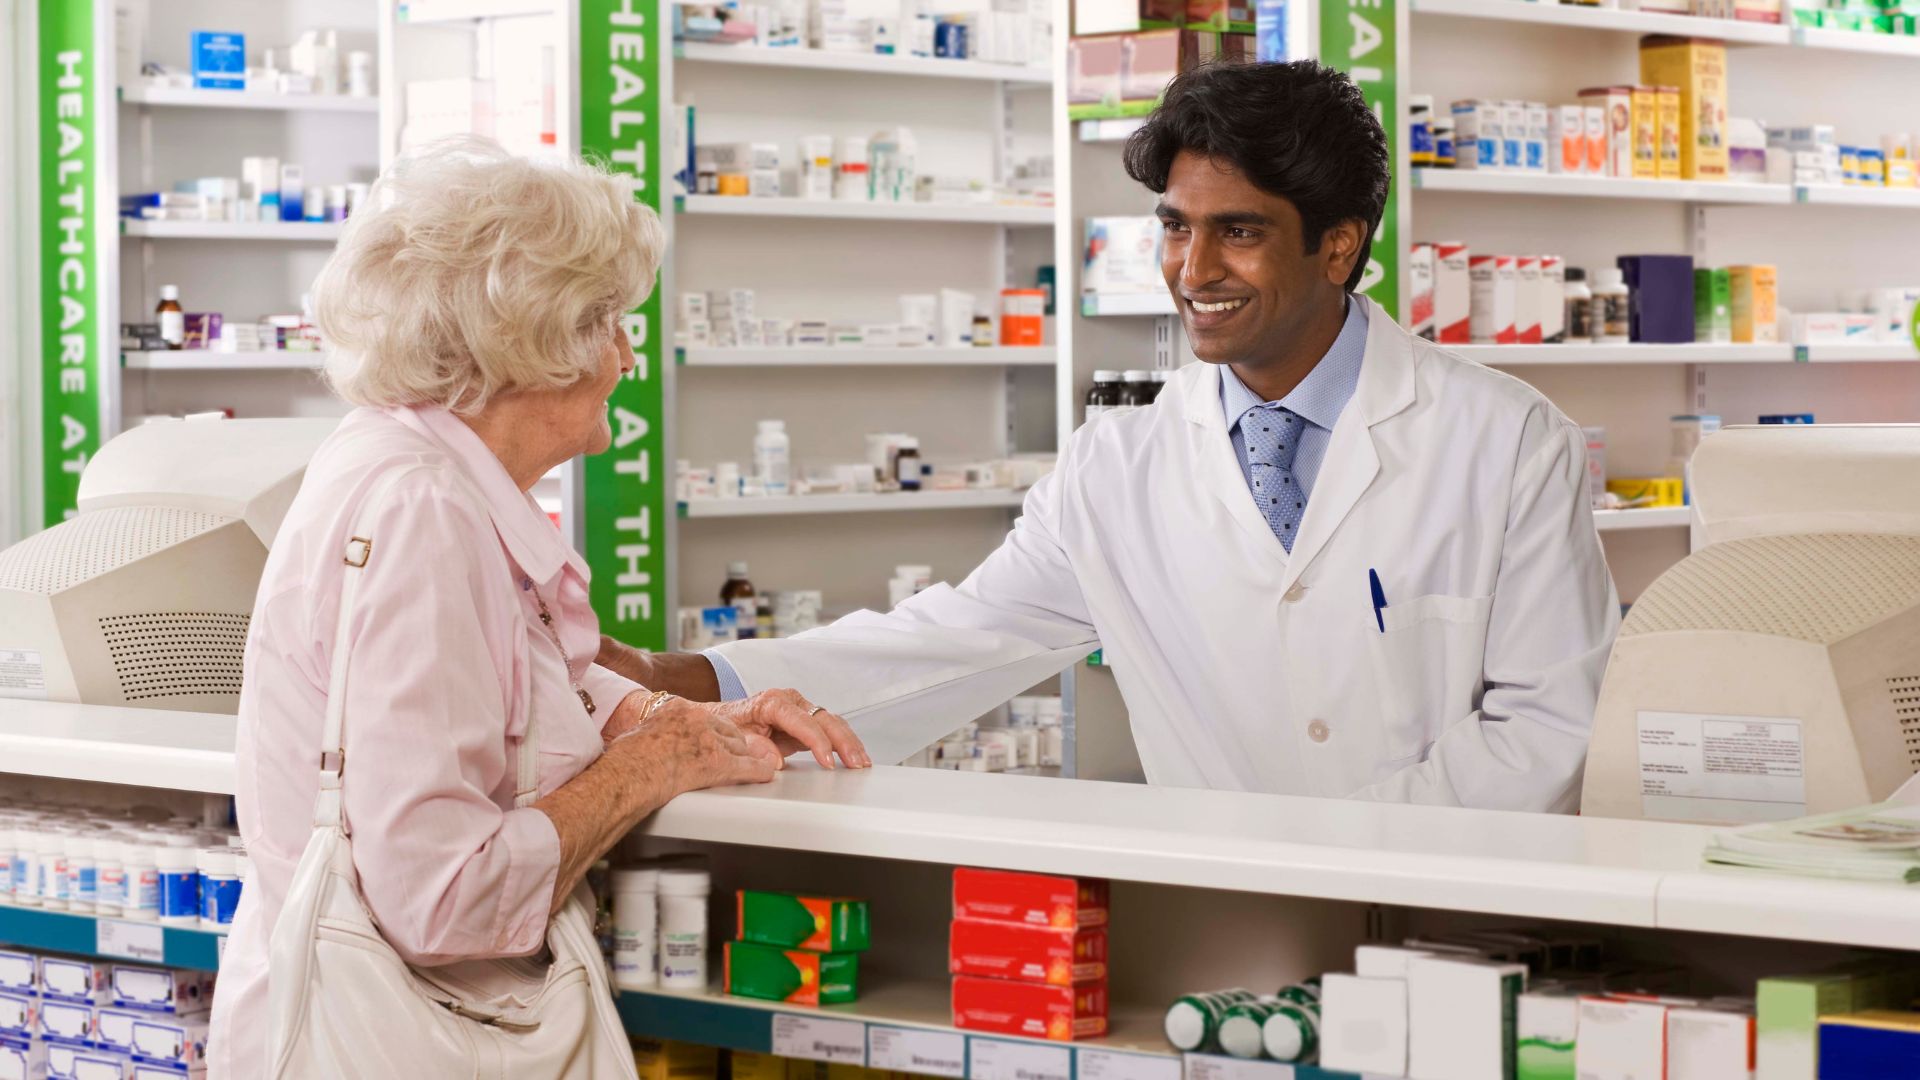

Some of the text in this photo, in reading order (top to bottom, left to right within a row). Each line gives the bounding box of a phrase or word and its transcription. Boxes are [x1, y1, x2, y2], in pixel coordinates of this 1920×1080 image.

[58, 50, 86, 479] HEALTHCARE AT
[614, 406, 649, 483] AT
[615, 505, 651, 622] THE
